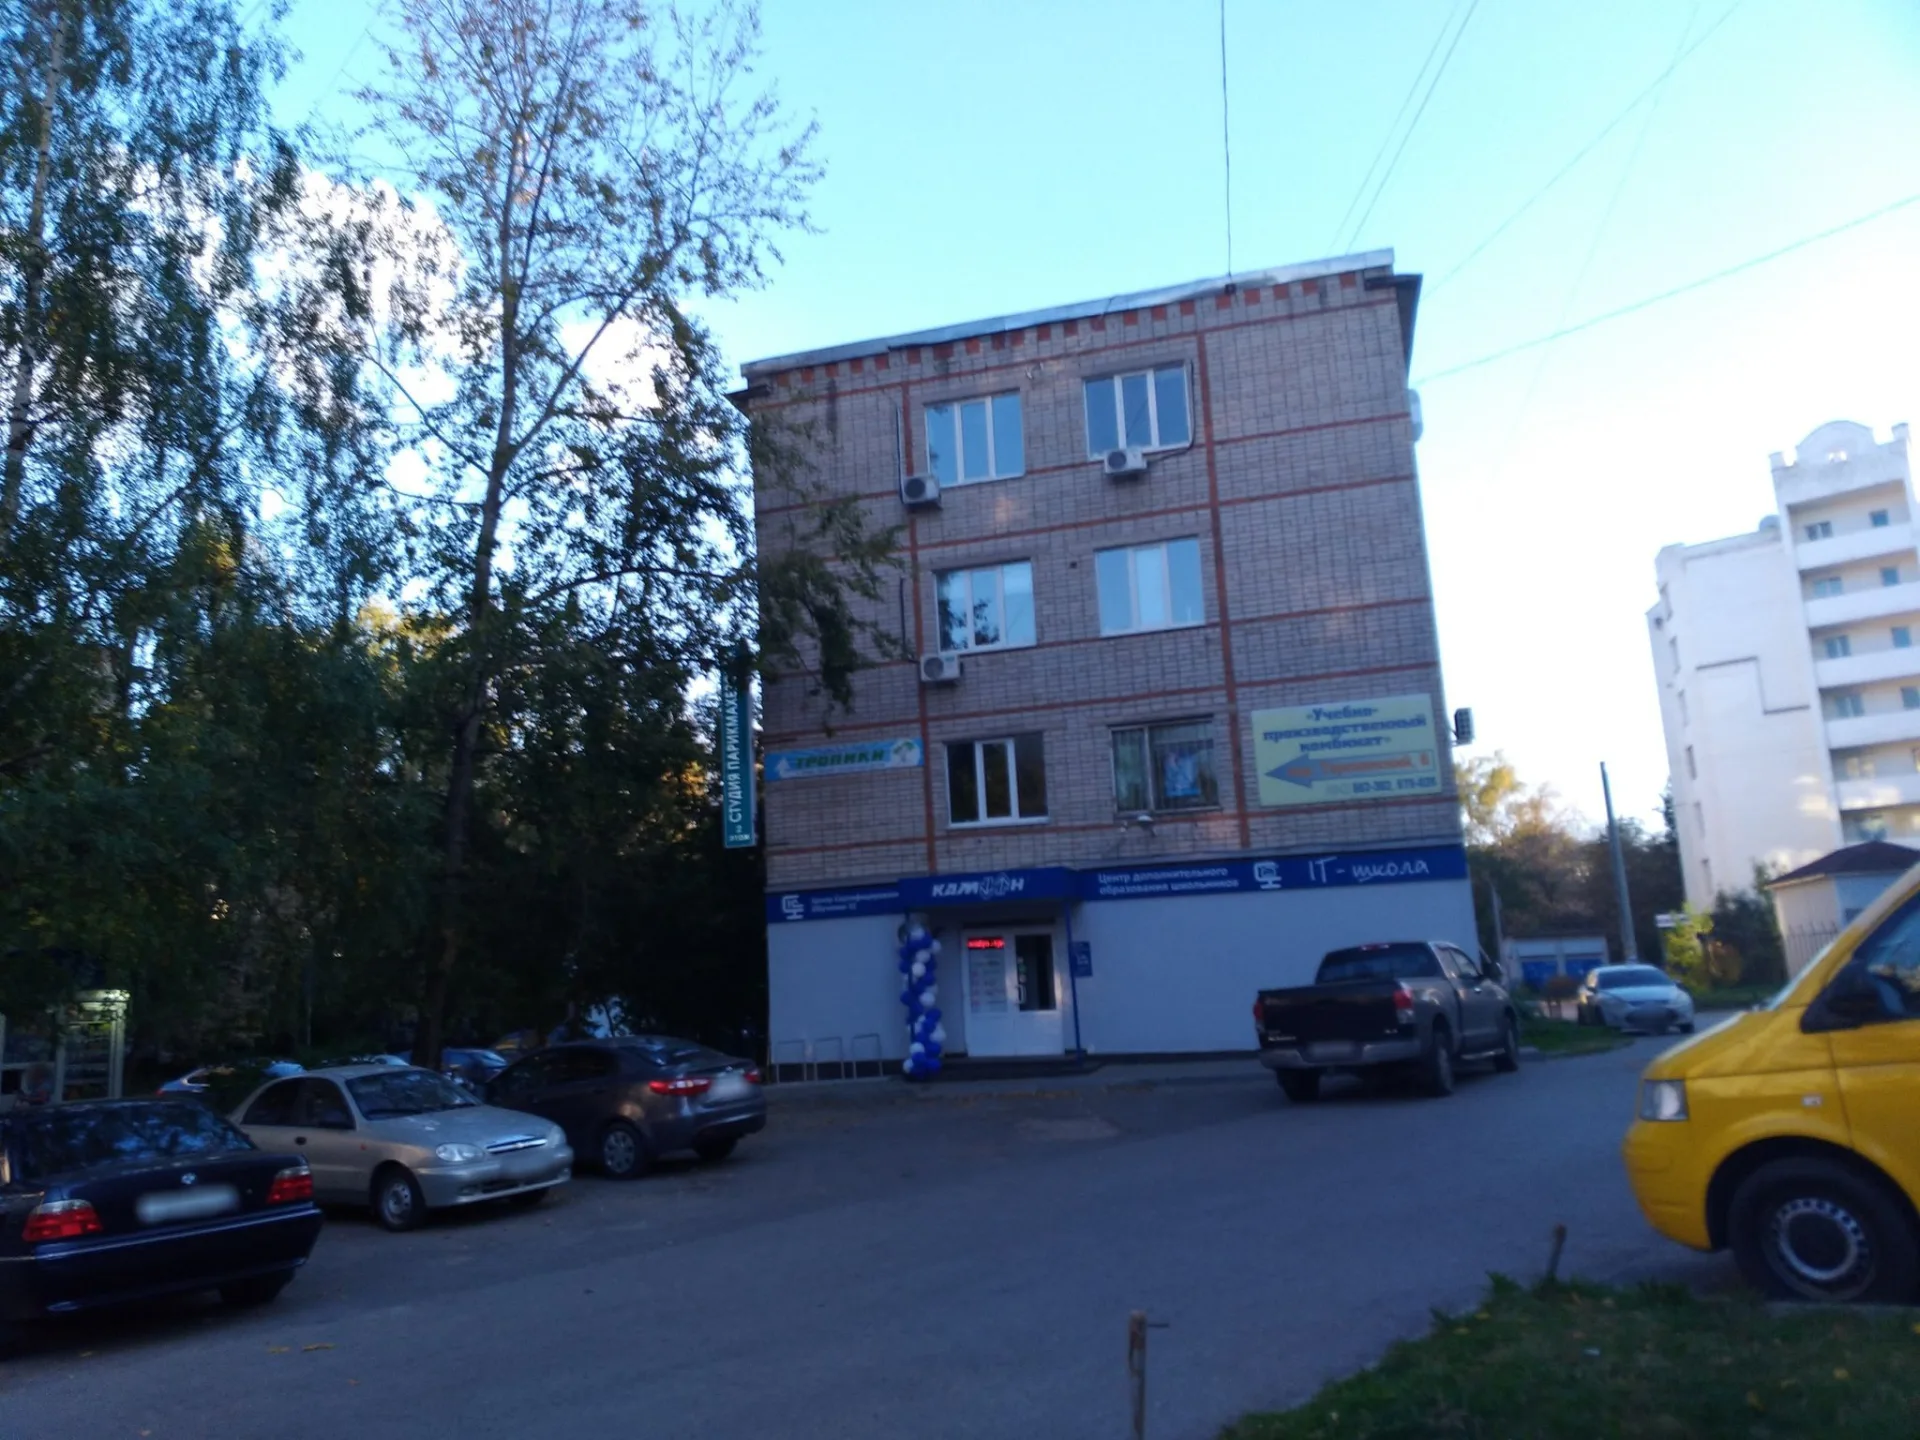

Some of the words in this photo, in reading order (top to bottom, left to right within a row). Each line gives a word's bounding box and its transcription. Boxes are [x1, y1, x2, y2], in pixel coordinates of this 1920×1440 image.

[795, 749, 885, 770] ТРОПИКИ
[727, 771, 743, 824] СТУДИЯ
[1098, 873, 1131, 884] Центр
[1132, 868, 1228, 882] дополнительного
[1099, 884, 1169, 895] образования
